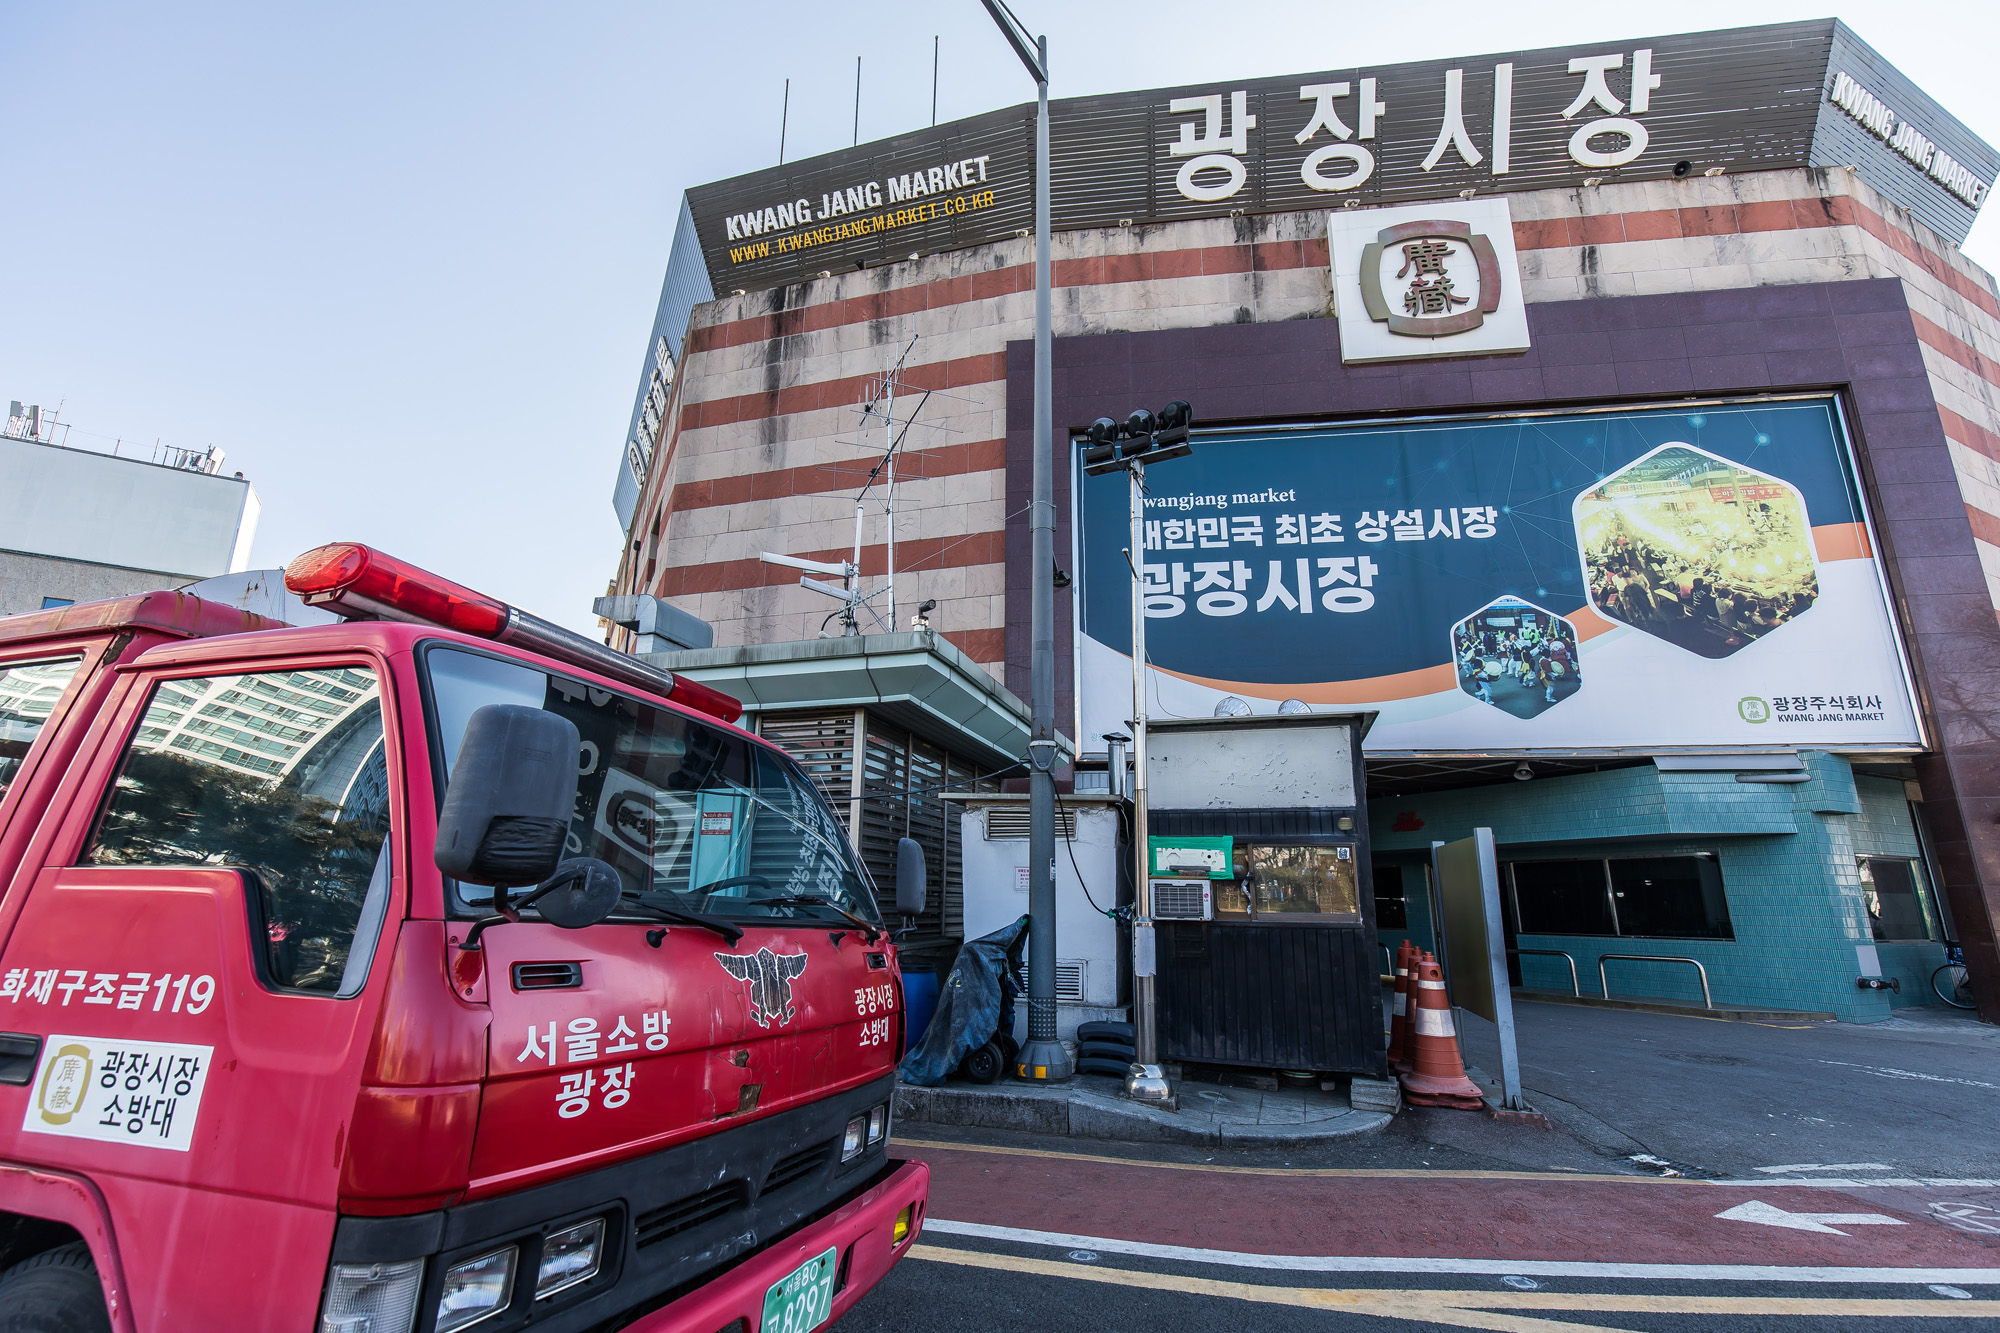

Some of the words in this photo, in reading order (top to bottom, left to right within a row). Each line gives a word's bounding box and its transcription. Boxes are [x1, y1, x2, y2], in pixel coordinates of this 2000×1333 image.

[1170, 48, 1661, 201] 광장시장
[1831, 71, 1894, 140] KWANG
[1889, 121, 1935, 170] JANG
[1929, 149, 1989, 210] MARKET
[726, 198, 812, 241] KWANG
[817, 181, 882, 220] JANG
[887, 155, 990, 204] MARKET
[1143, 492, 1228, 511] wangjang
[1232, 488, 1296, 505] market
[1275, 512, 1345, 545] 최초
[1355, 505, 1498, 543] 상설시장
[1143, 555, 1379, 618] 광장시장
[1773, 695, 1882, 711] 광장주식회사
[1778, 714, 1814, 722] KWANG
[1817, 713, 1843, 722] JANG
[1845, 712, 1884, 721] MARKET
[0, 968, 216, 1015] 화재구조급119
[854, 987, 894, 1015] 광장시장
[516, 1010, 671, 1066] 서울소방
[859, 1016, 889, 1047] 소방대
[100, 1051, 199, 1096] 광장시장
[555, 1063, 636, 1119] 광장
[99, 1094, 177, 1138] 소방대
[784, 1261, 818, 1297] 서울80
